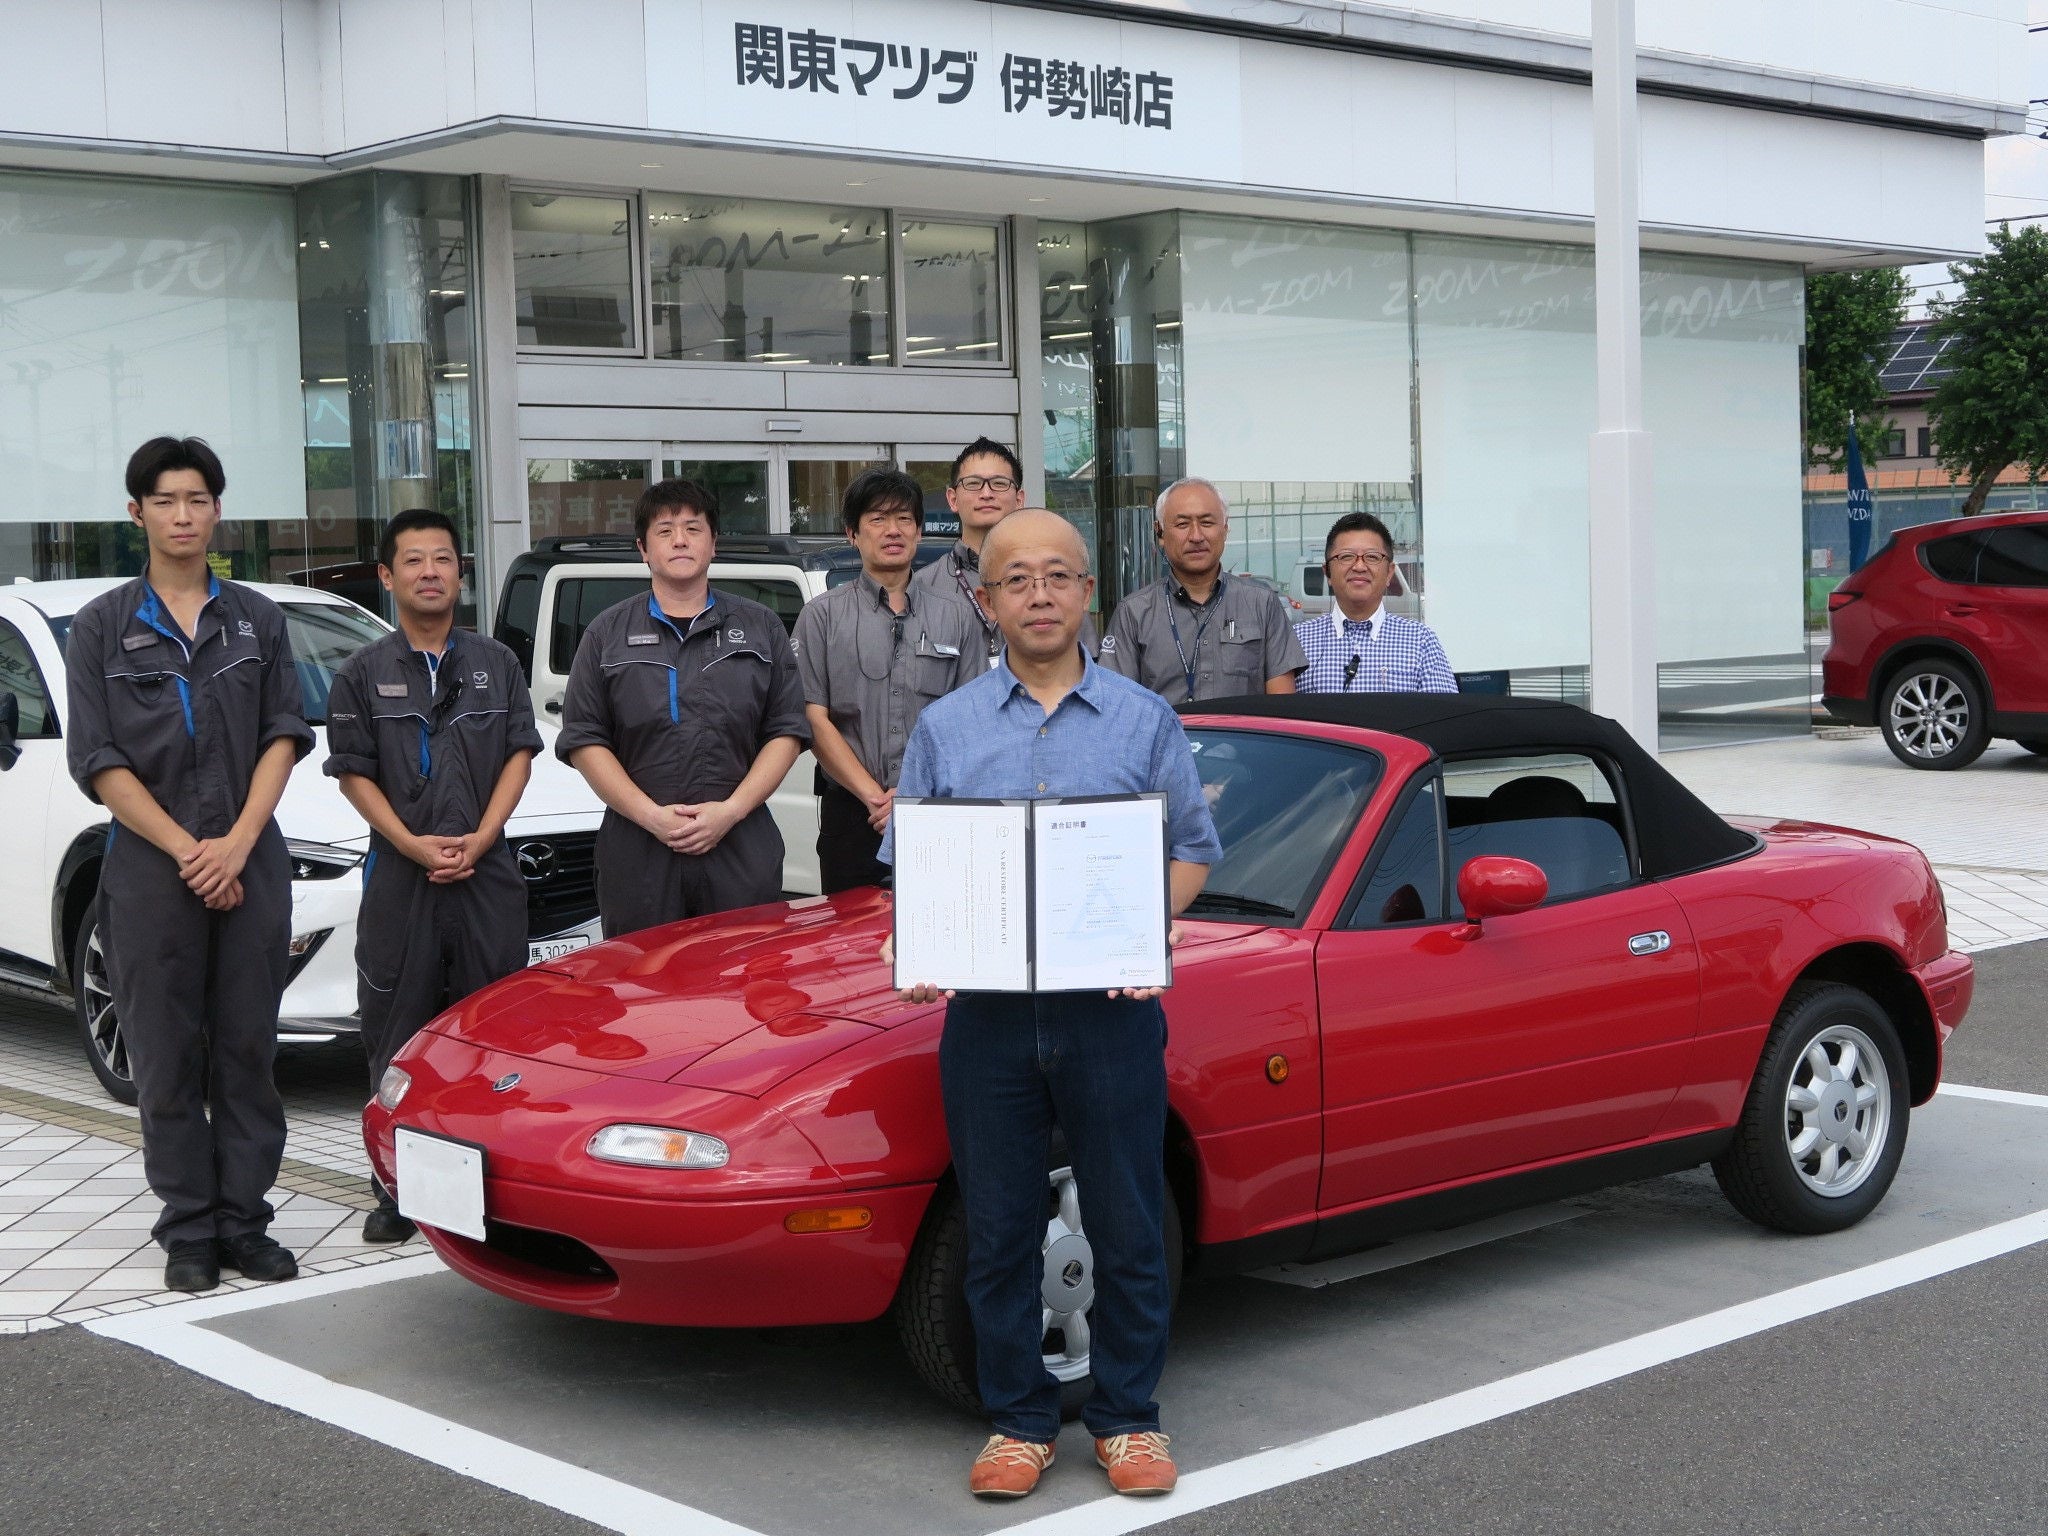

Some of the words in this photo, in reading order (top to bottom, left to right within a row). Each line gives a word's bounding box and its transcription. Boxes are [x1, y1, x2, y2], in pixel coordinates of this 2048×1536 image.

[734, 22, 978, 104] 関東マツダ
[999, 52, 1174, 130] 伊勢崎店
[924, 521, 960, 532] 関東マツダ
